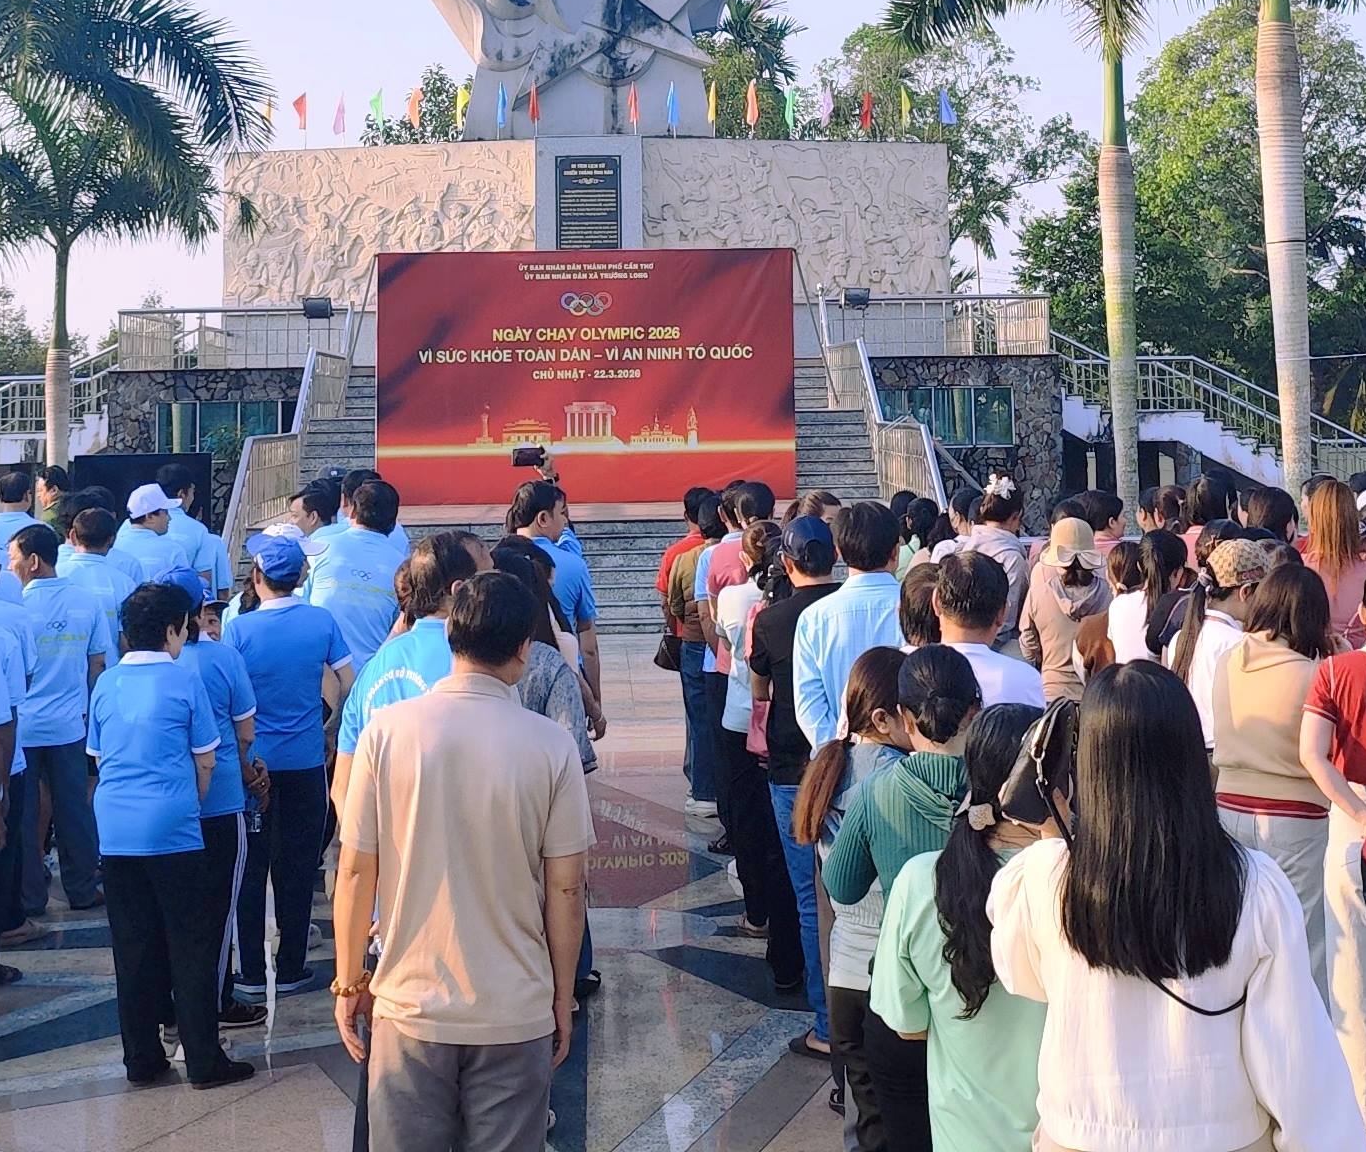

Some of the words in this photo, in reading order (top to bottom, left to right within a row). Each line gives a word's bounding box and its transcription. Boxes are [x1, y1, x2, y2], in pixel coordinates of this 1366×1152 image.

[492, 326, 533, 342] NGÀY
[536, 328, 578, 343] CHẠY
[580, 327, 645, 341] OLYMPIC
[648, 326, 681, 339] 2026
[418, 349, 433, 364] VÌ
[435, 348, 467, 363] SỨC
[470, 347, 512, 363] KHỎE
[514, 347, 556, 362] TOÀN
[560, 347, 591, 362] DÂN
[605, 346, 620, 361] VÌ
[622, 348, 643, 361] AN
[646, 347, 683, 360] NINH
[710, 343, 753, 360] QUỐC
[532, 367, 555, 379] CHỦ
[556, 368, 585, 381] NHẬT
